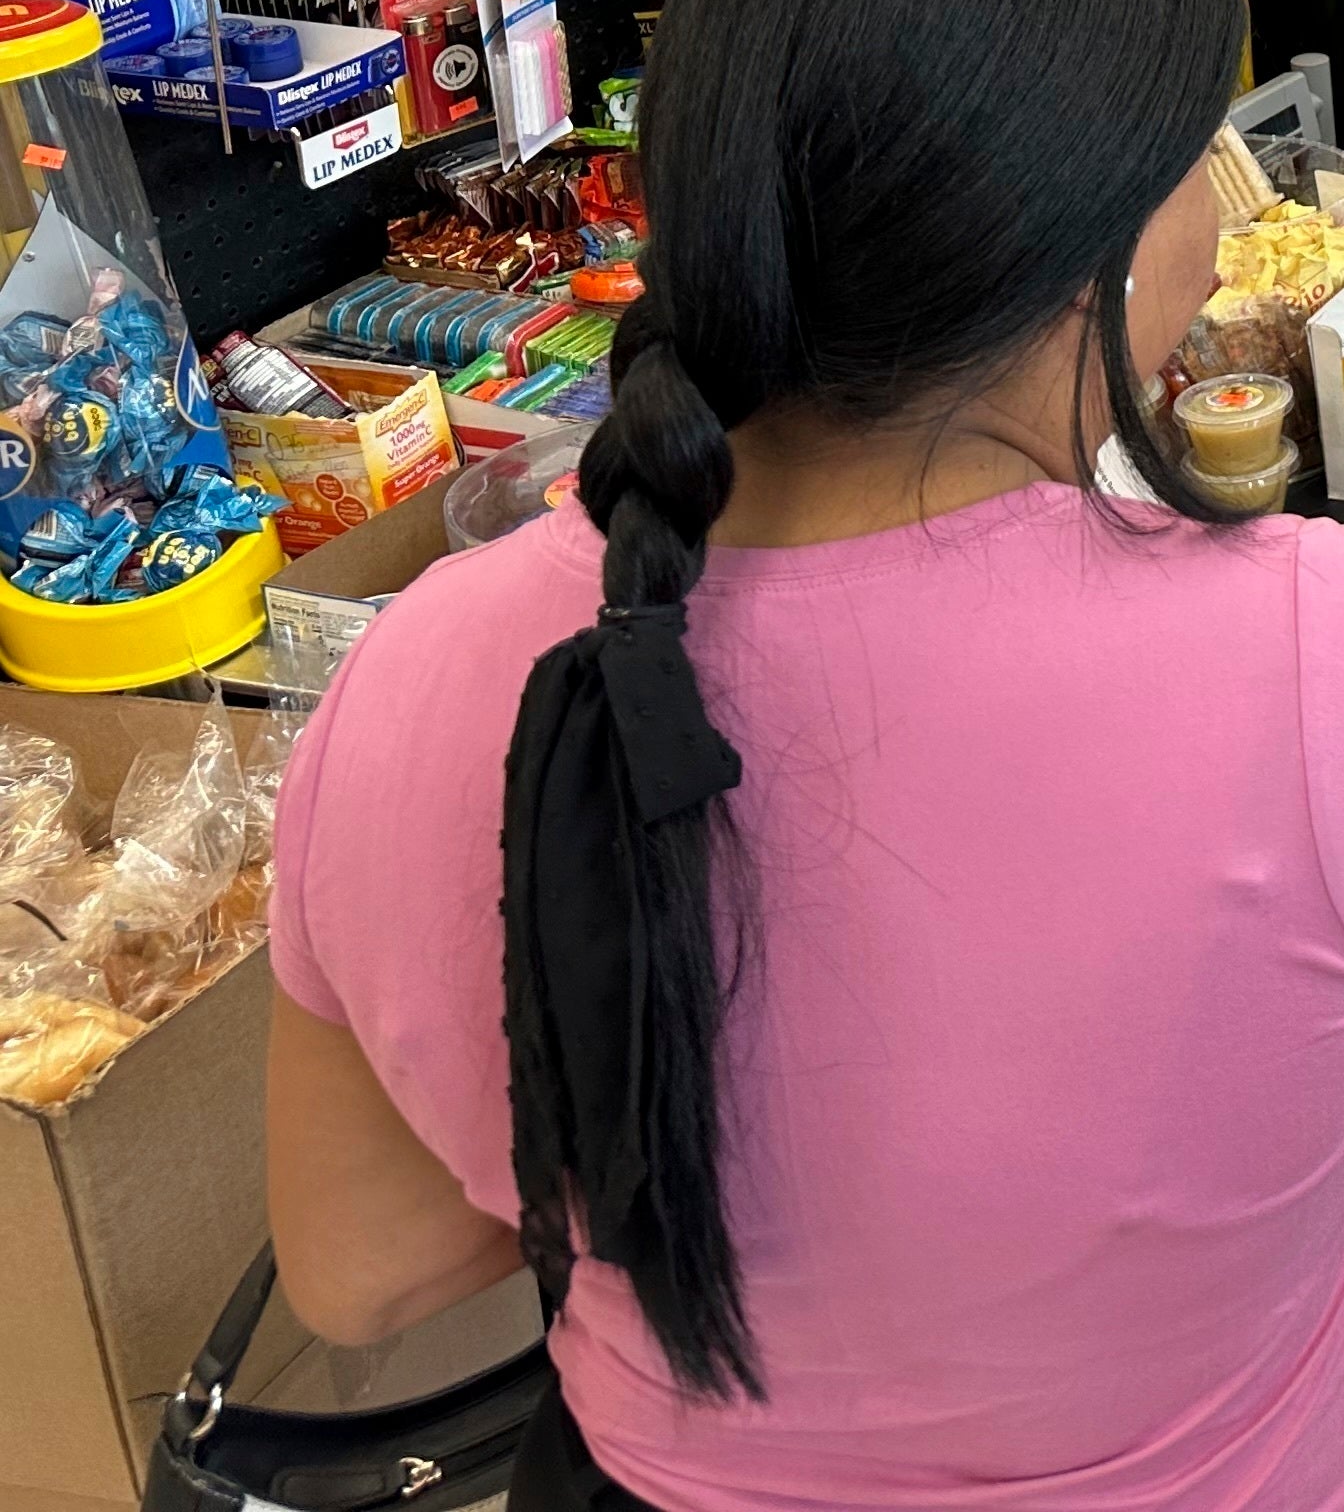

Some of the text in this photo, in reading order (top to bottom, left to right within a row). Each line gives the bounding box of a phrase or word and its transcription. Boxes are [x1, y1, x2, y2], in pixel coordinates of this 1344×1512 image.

[152, 80, 209, 101] LIP MEDEX
[277, 60, 362, 105] Blistex LIP MEDEX
[313, 133, 395, 182] LIP MEDEX
[375, 388, 428, 438] Emergen-C
[386, 432, 424, 461] Vitamin
[394, 453, 440, 489] Super Orange
